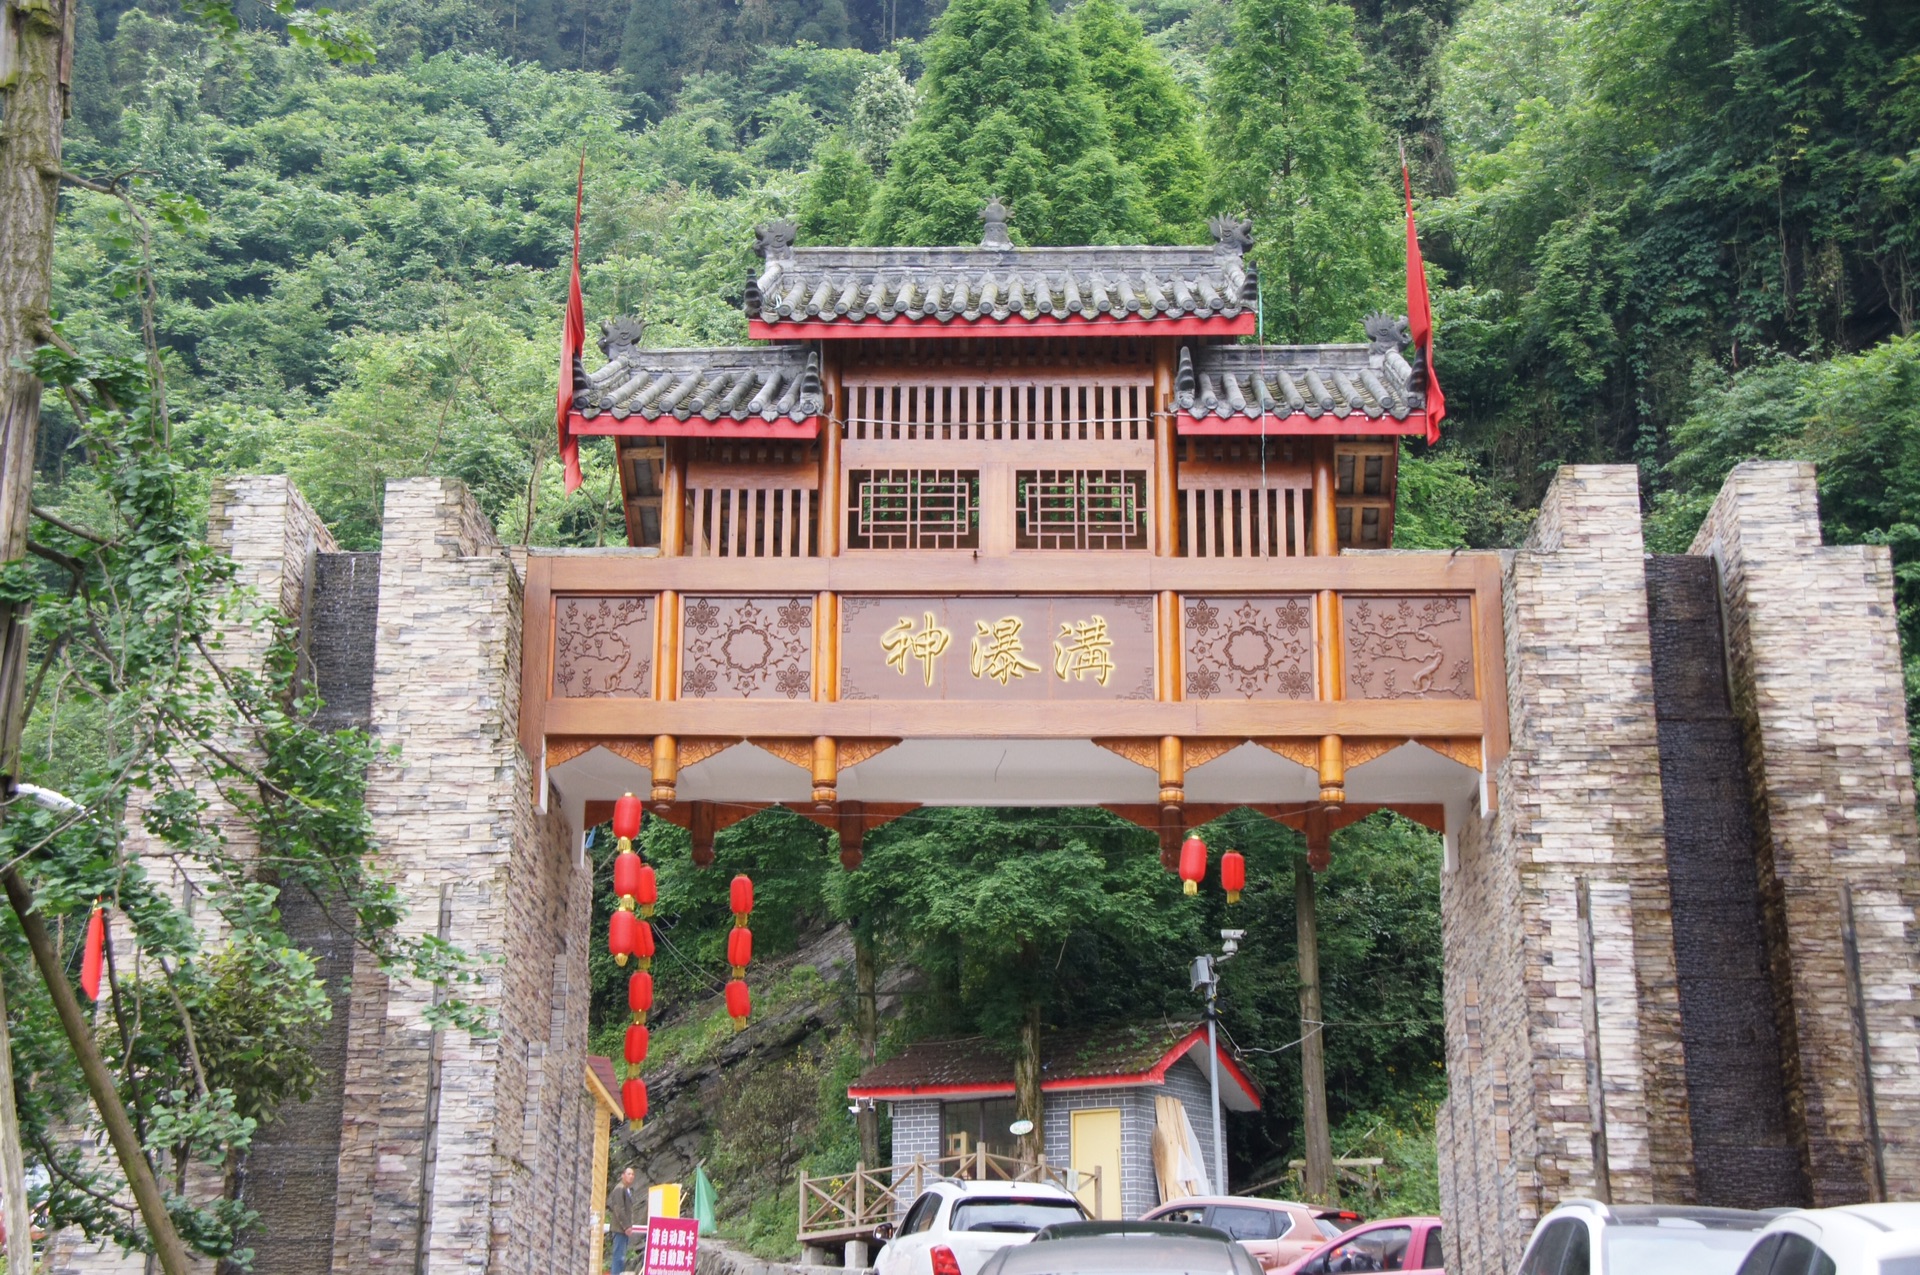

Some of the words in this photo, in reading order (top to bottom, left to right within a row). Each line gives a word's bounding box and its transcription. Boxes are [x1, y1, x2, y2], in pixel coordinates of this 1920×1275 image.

[880, 611, 1114, 687] 神瀑溝
[651, 1227, 695, 1248] 请自动取卡
